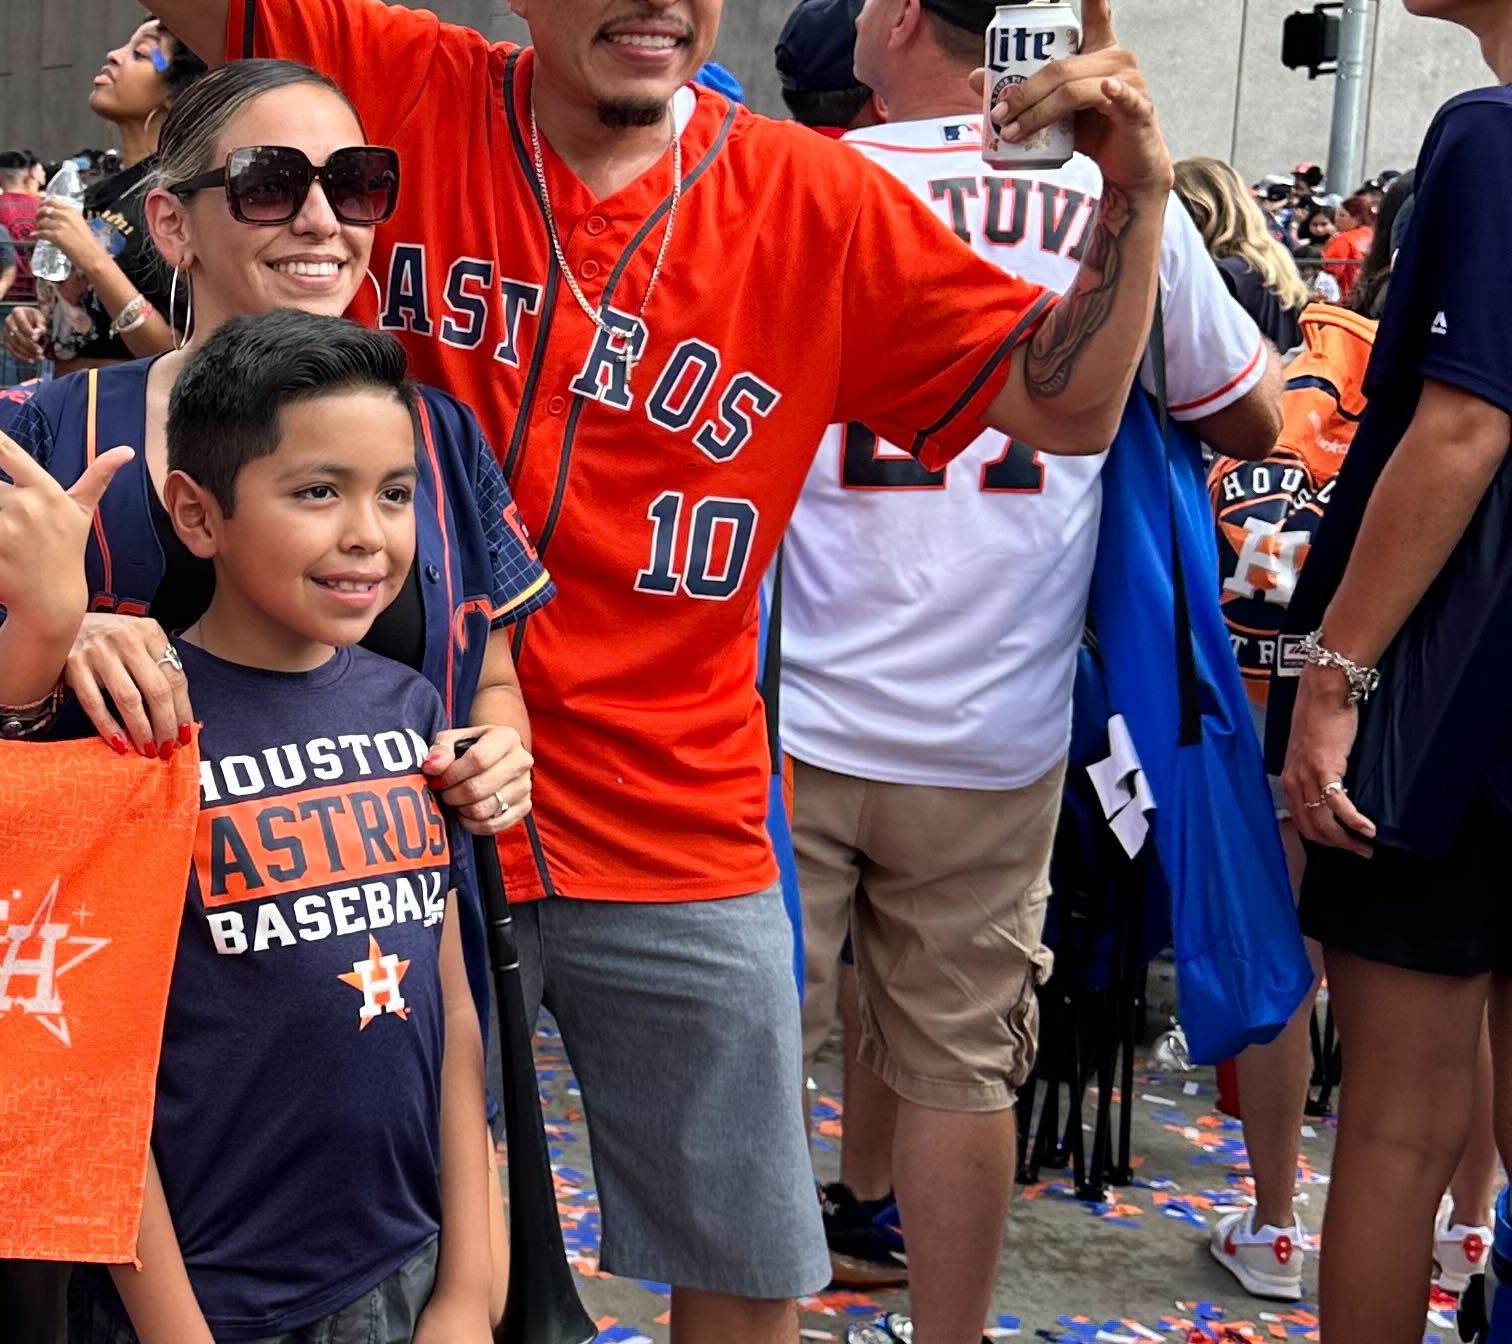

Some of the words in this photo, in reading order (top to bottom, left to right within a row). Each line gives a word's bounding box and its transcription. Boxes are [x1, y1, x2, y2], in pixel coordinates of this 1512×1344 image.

[989, 27, 1055, 72] Lite
[634, 490, 759, 601] 10
[210, 783, 448, 898] ASTROS
